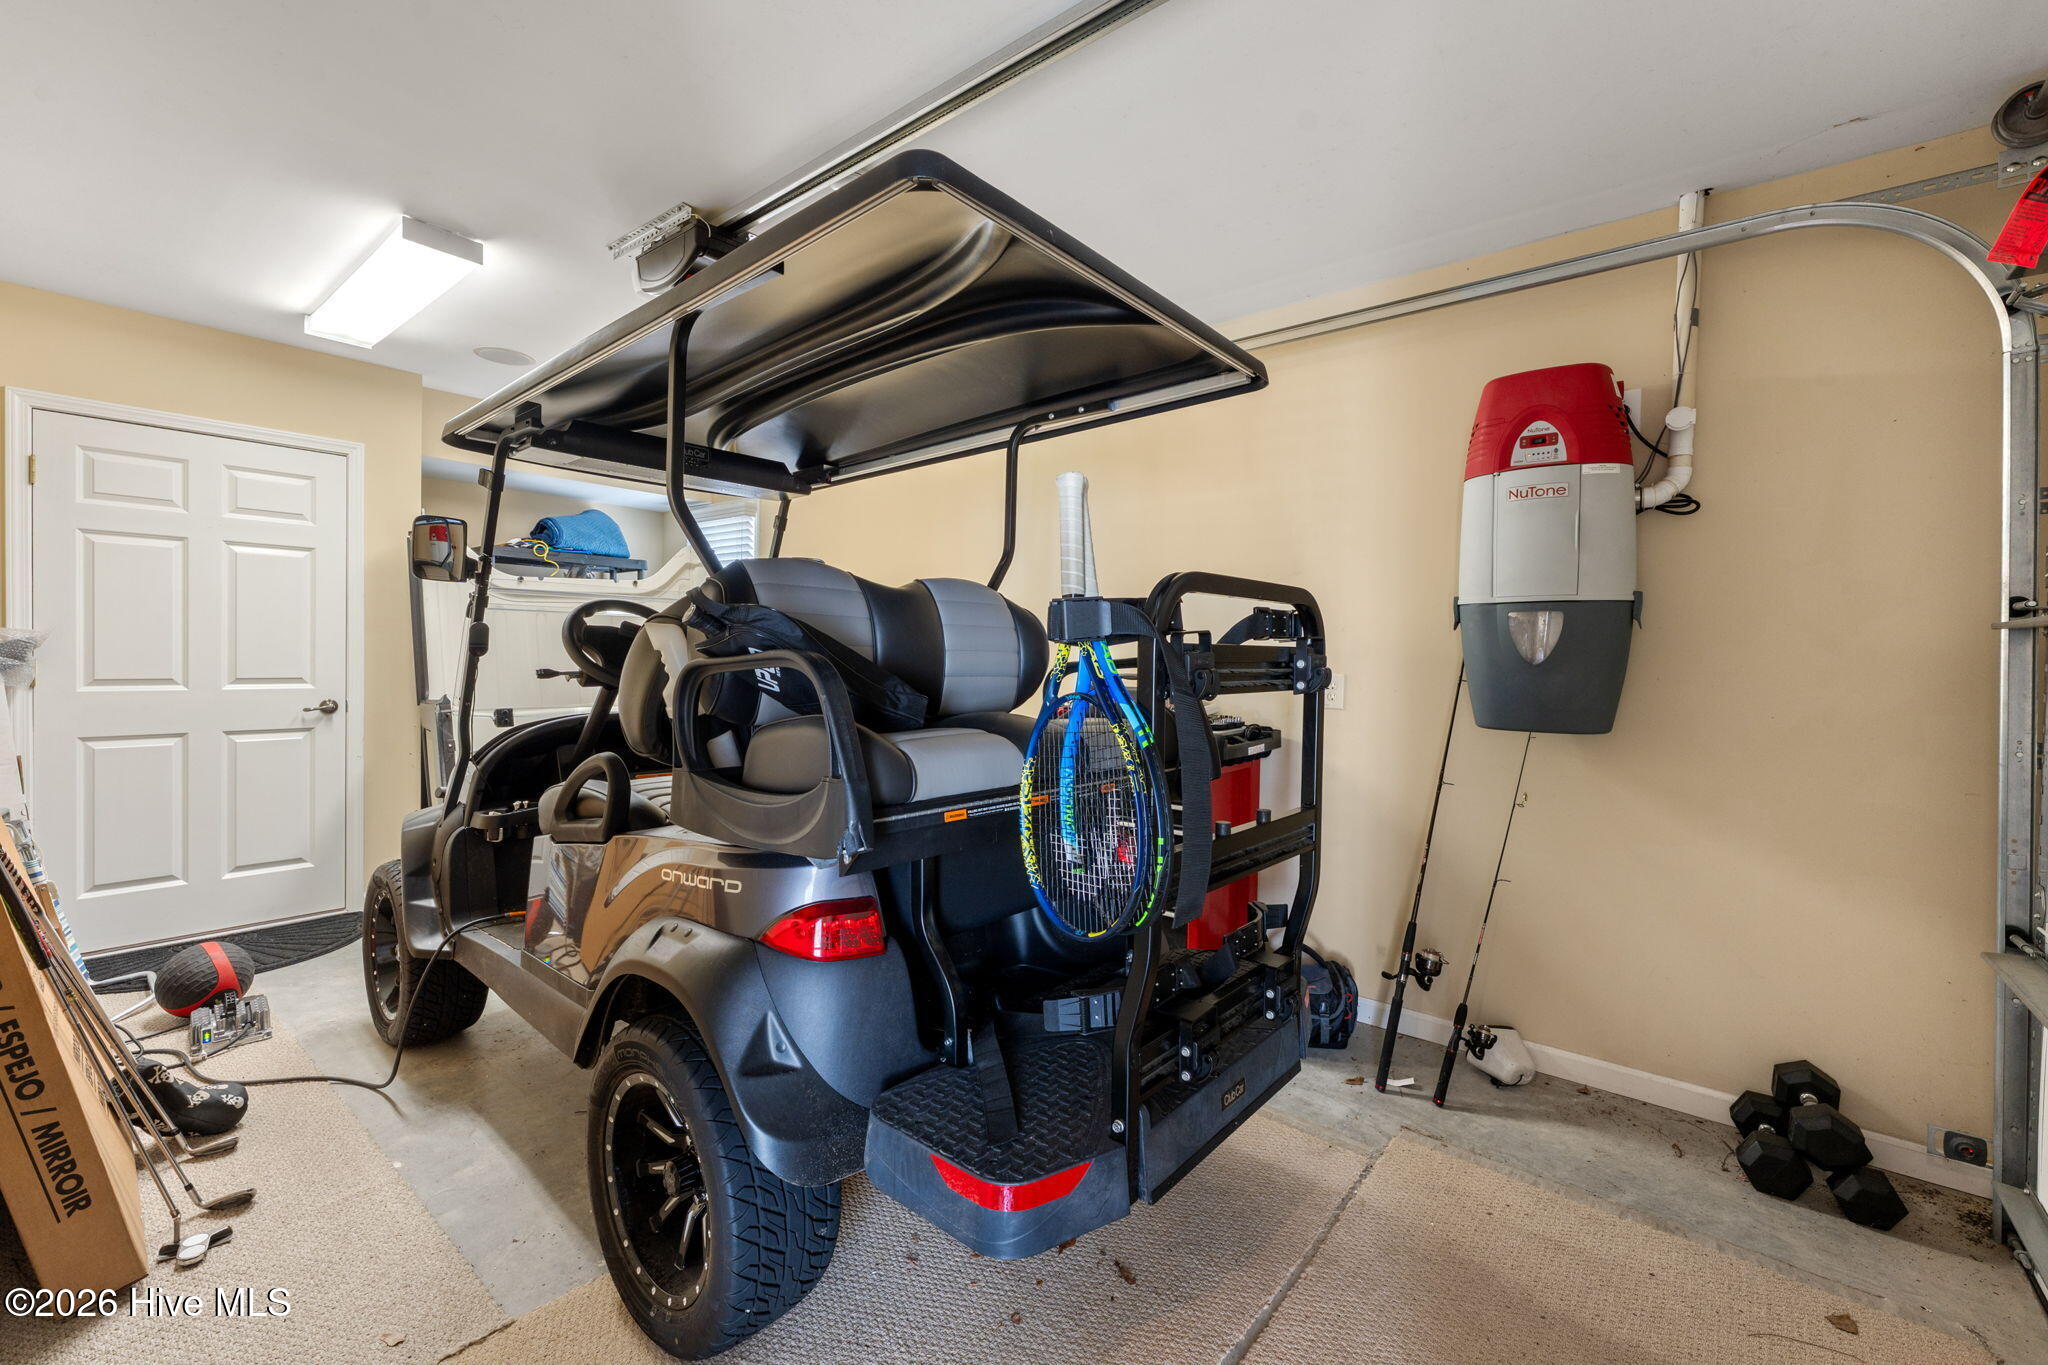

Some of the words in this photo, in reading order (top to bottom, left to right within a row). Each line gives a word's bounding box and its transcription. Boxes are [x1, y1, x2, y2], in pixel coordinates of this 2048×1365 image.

[1508, 486, 1567, 500] NuTone
[0, 1018, 45, 1100] ESPEJO
[31, 1121, 92, 1218] MIRROIR
